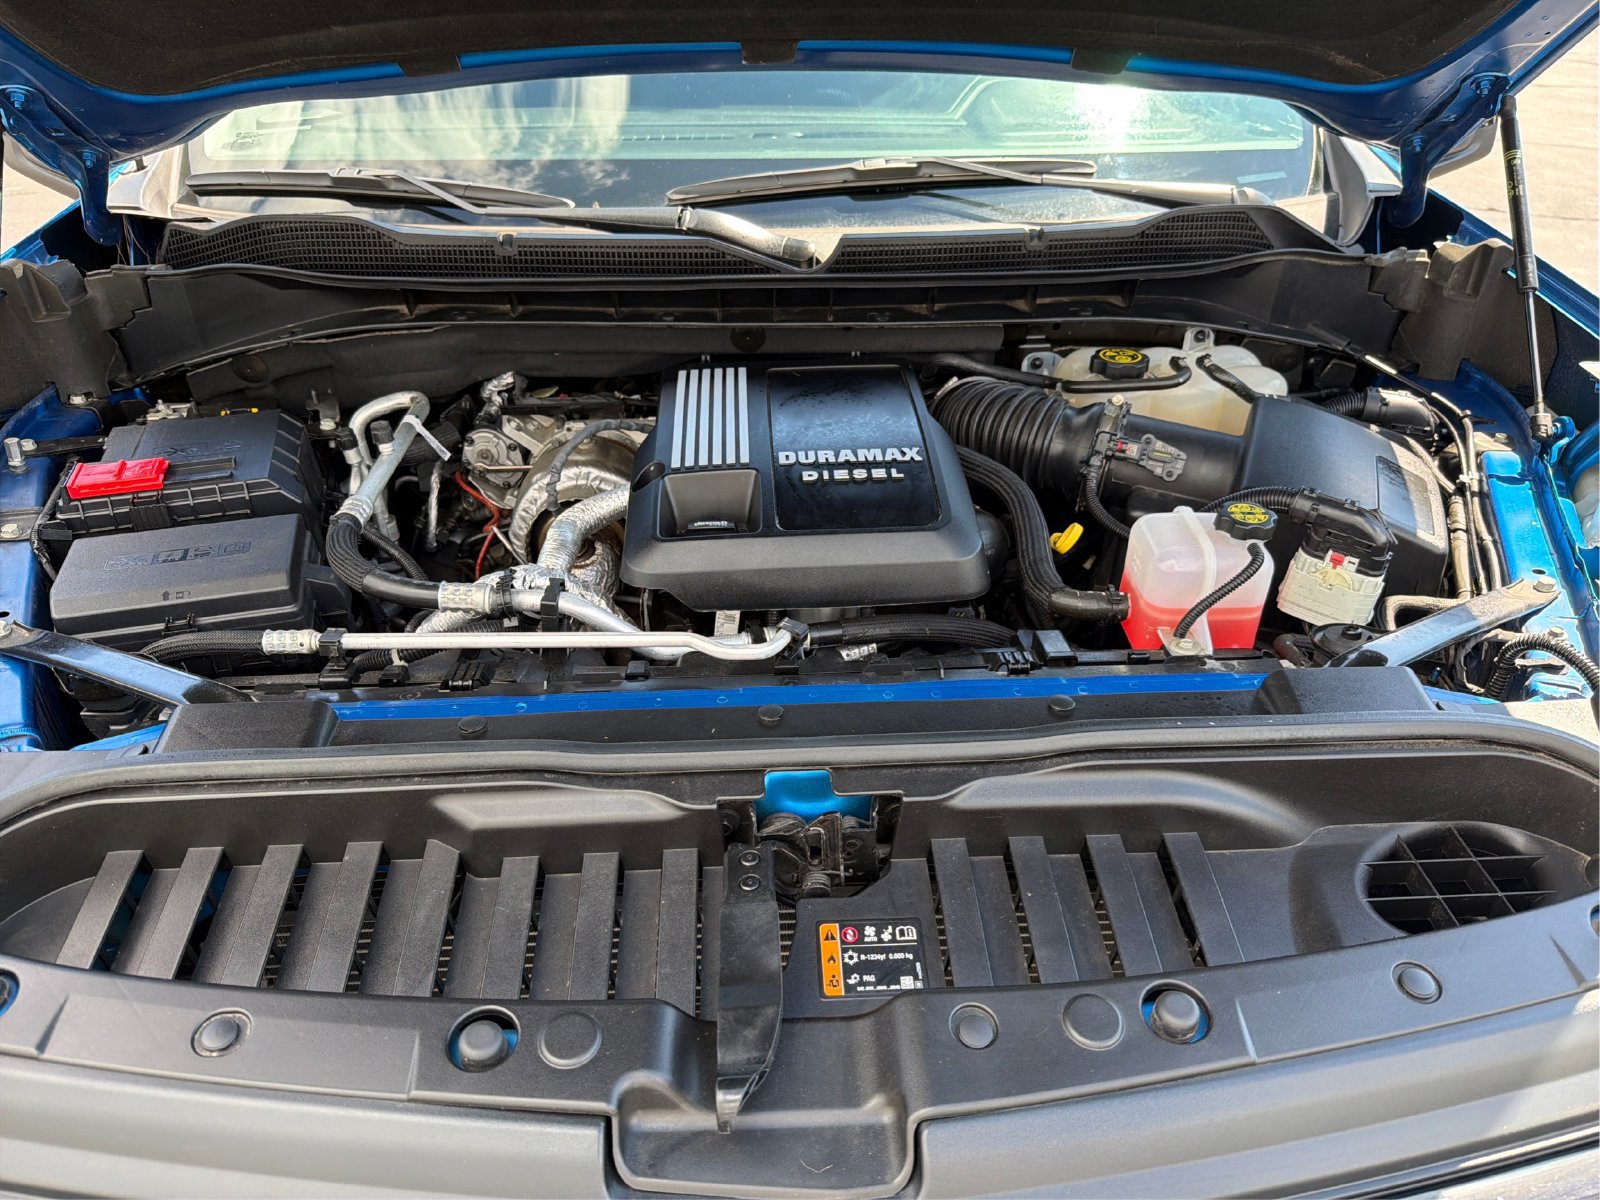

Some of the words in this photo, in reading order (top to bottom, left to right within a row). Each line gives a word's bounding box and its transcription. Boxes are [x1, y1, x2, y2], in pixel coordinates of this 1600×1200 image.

[778, 447, 923, 465] DURAMAX
[801, 468, 905, 482] DIESEL
[905, 952, 913, 960] kg
[862, 974, 876, 982] PAG
